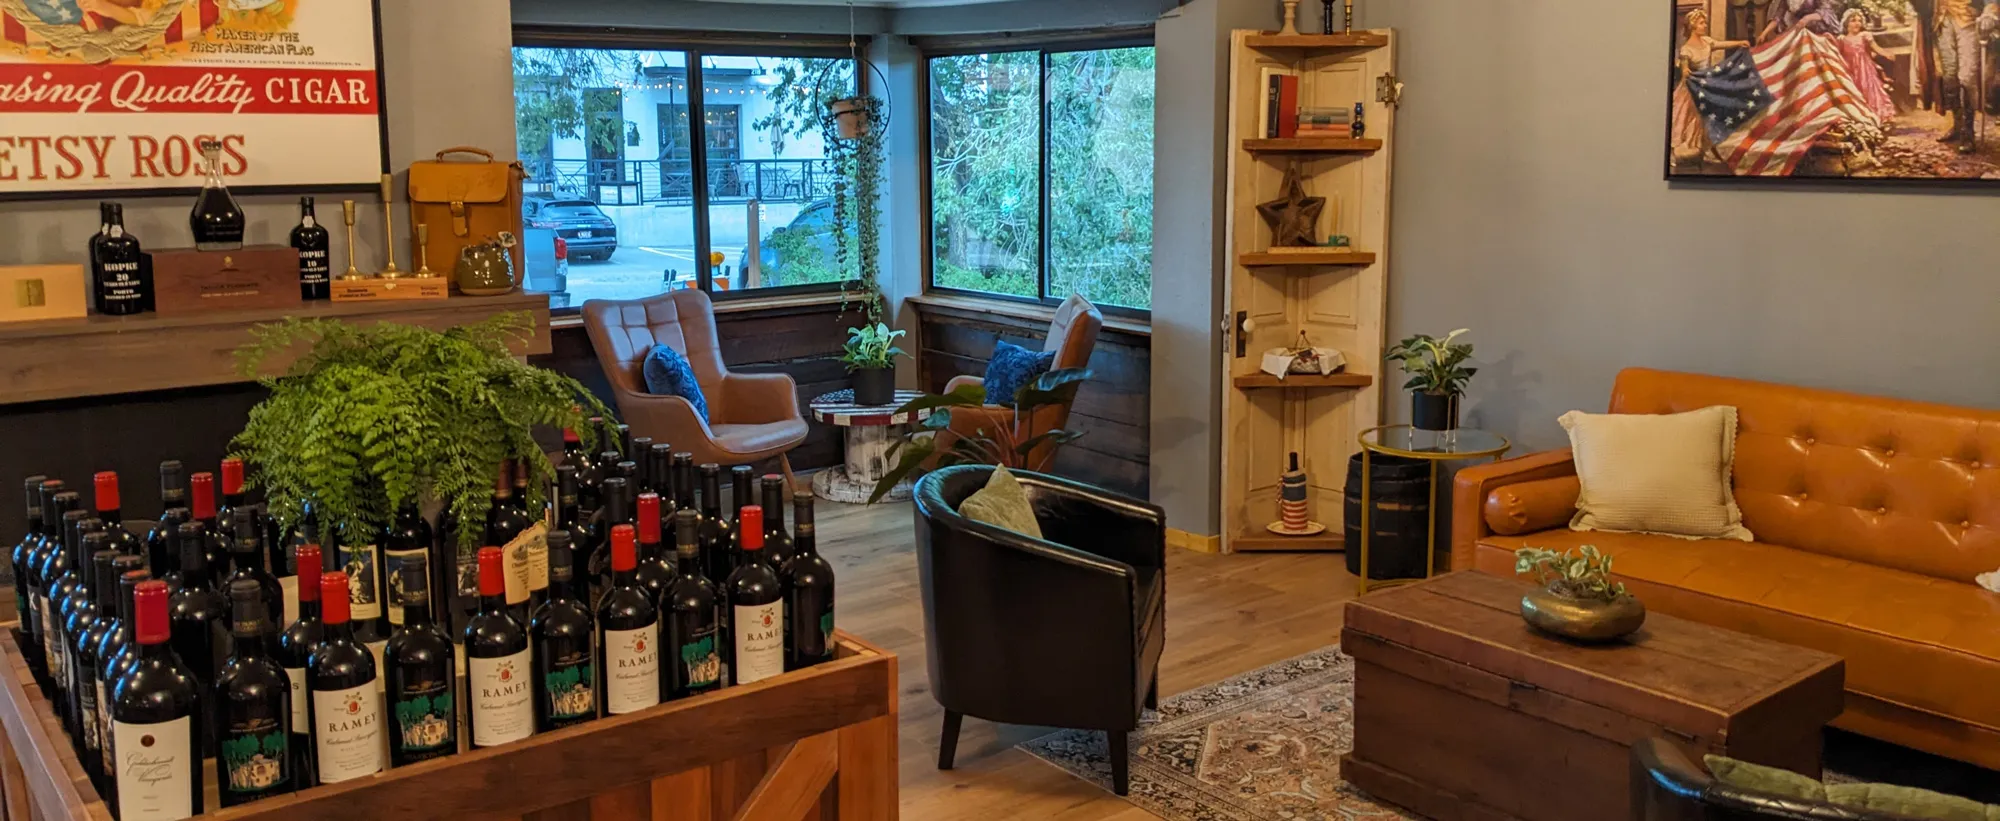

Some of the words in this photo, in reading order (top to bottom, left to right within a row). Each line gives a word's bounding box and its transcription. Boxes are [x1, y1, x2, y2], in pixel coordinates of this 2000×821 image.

[216, 28, 257, 41] MAKER
[258, 31, 274, 41] OF
[279, 32, 300, 43] THE
[190, 42, 224, 53] FIRST
[225, 42, 285, 56] AMERICAN
[110, 70, 255, 114] Quality
[265, 77, 370, 105] CIGAR
[128, 134, 248, 179] ROSS
[104, 262, 138, 271] KOPKE
[116, 273, 129, 281] 20
[747, 626, 782, 641] RAME
[482, 680, 528, 698] RAMEY
[328, 711, 377, 733] RAMEY
